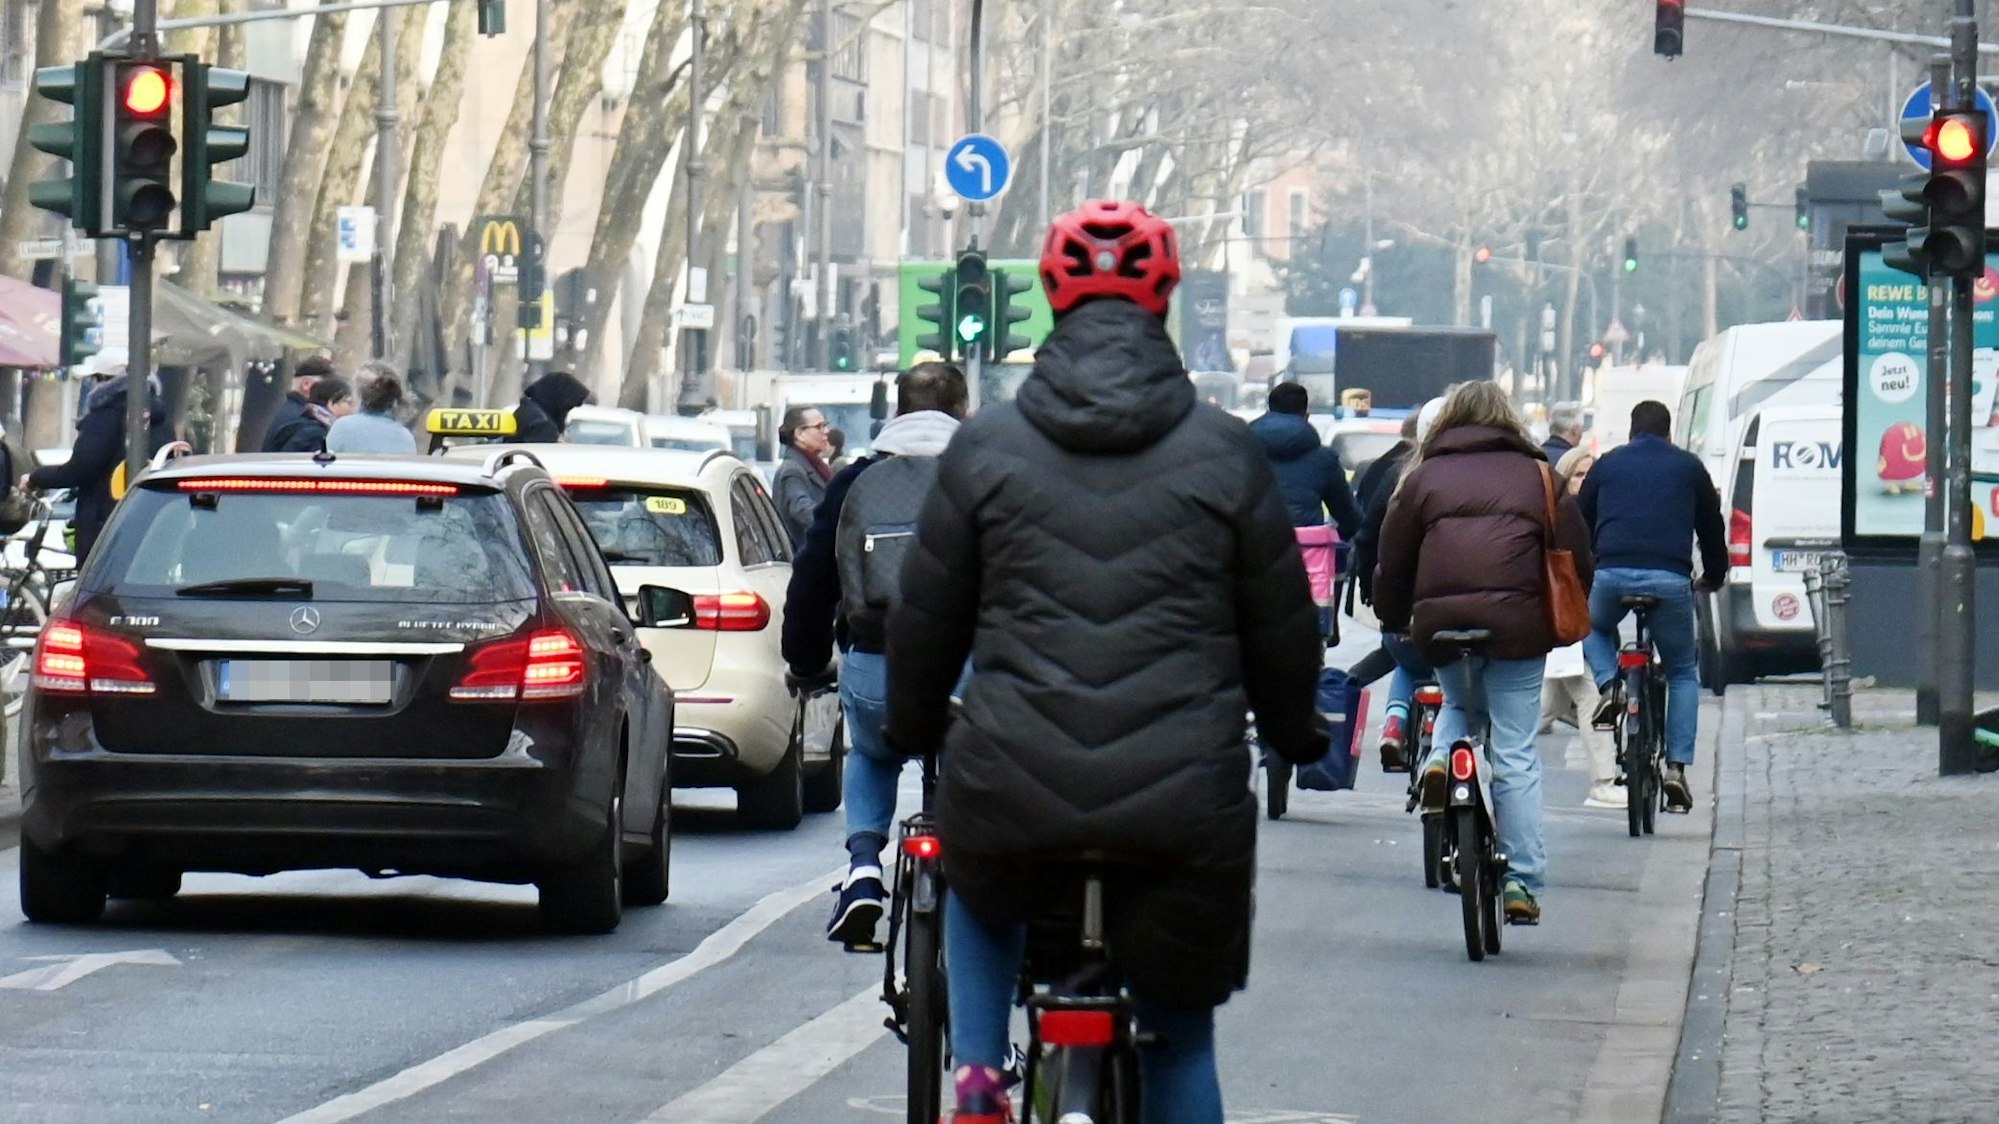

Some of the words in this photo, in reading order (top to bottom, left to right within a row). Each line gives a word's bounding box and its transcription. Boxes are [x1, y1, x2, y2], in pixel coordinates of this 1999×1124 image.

[1868, 285, 1913, 301] REWE
[1868, 306, 1894, 319] Dein
[1868, 321, 1911, 334] Sammle
[1868, 337, 1906, 348] deinem
[1881, 365, 1907, 376] Jetzt
[1881, 376, 1910, 391] neu!
[443, 413, 498, 429] TAXI
[655, 499, 677, 510] 189
